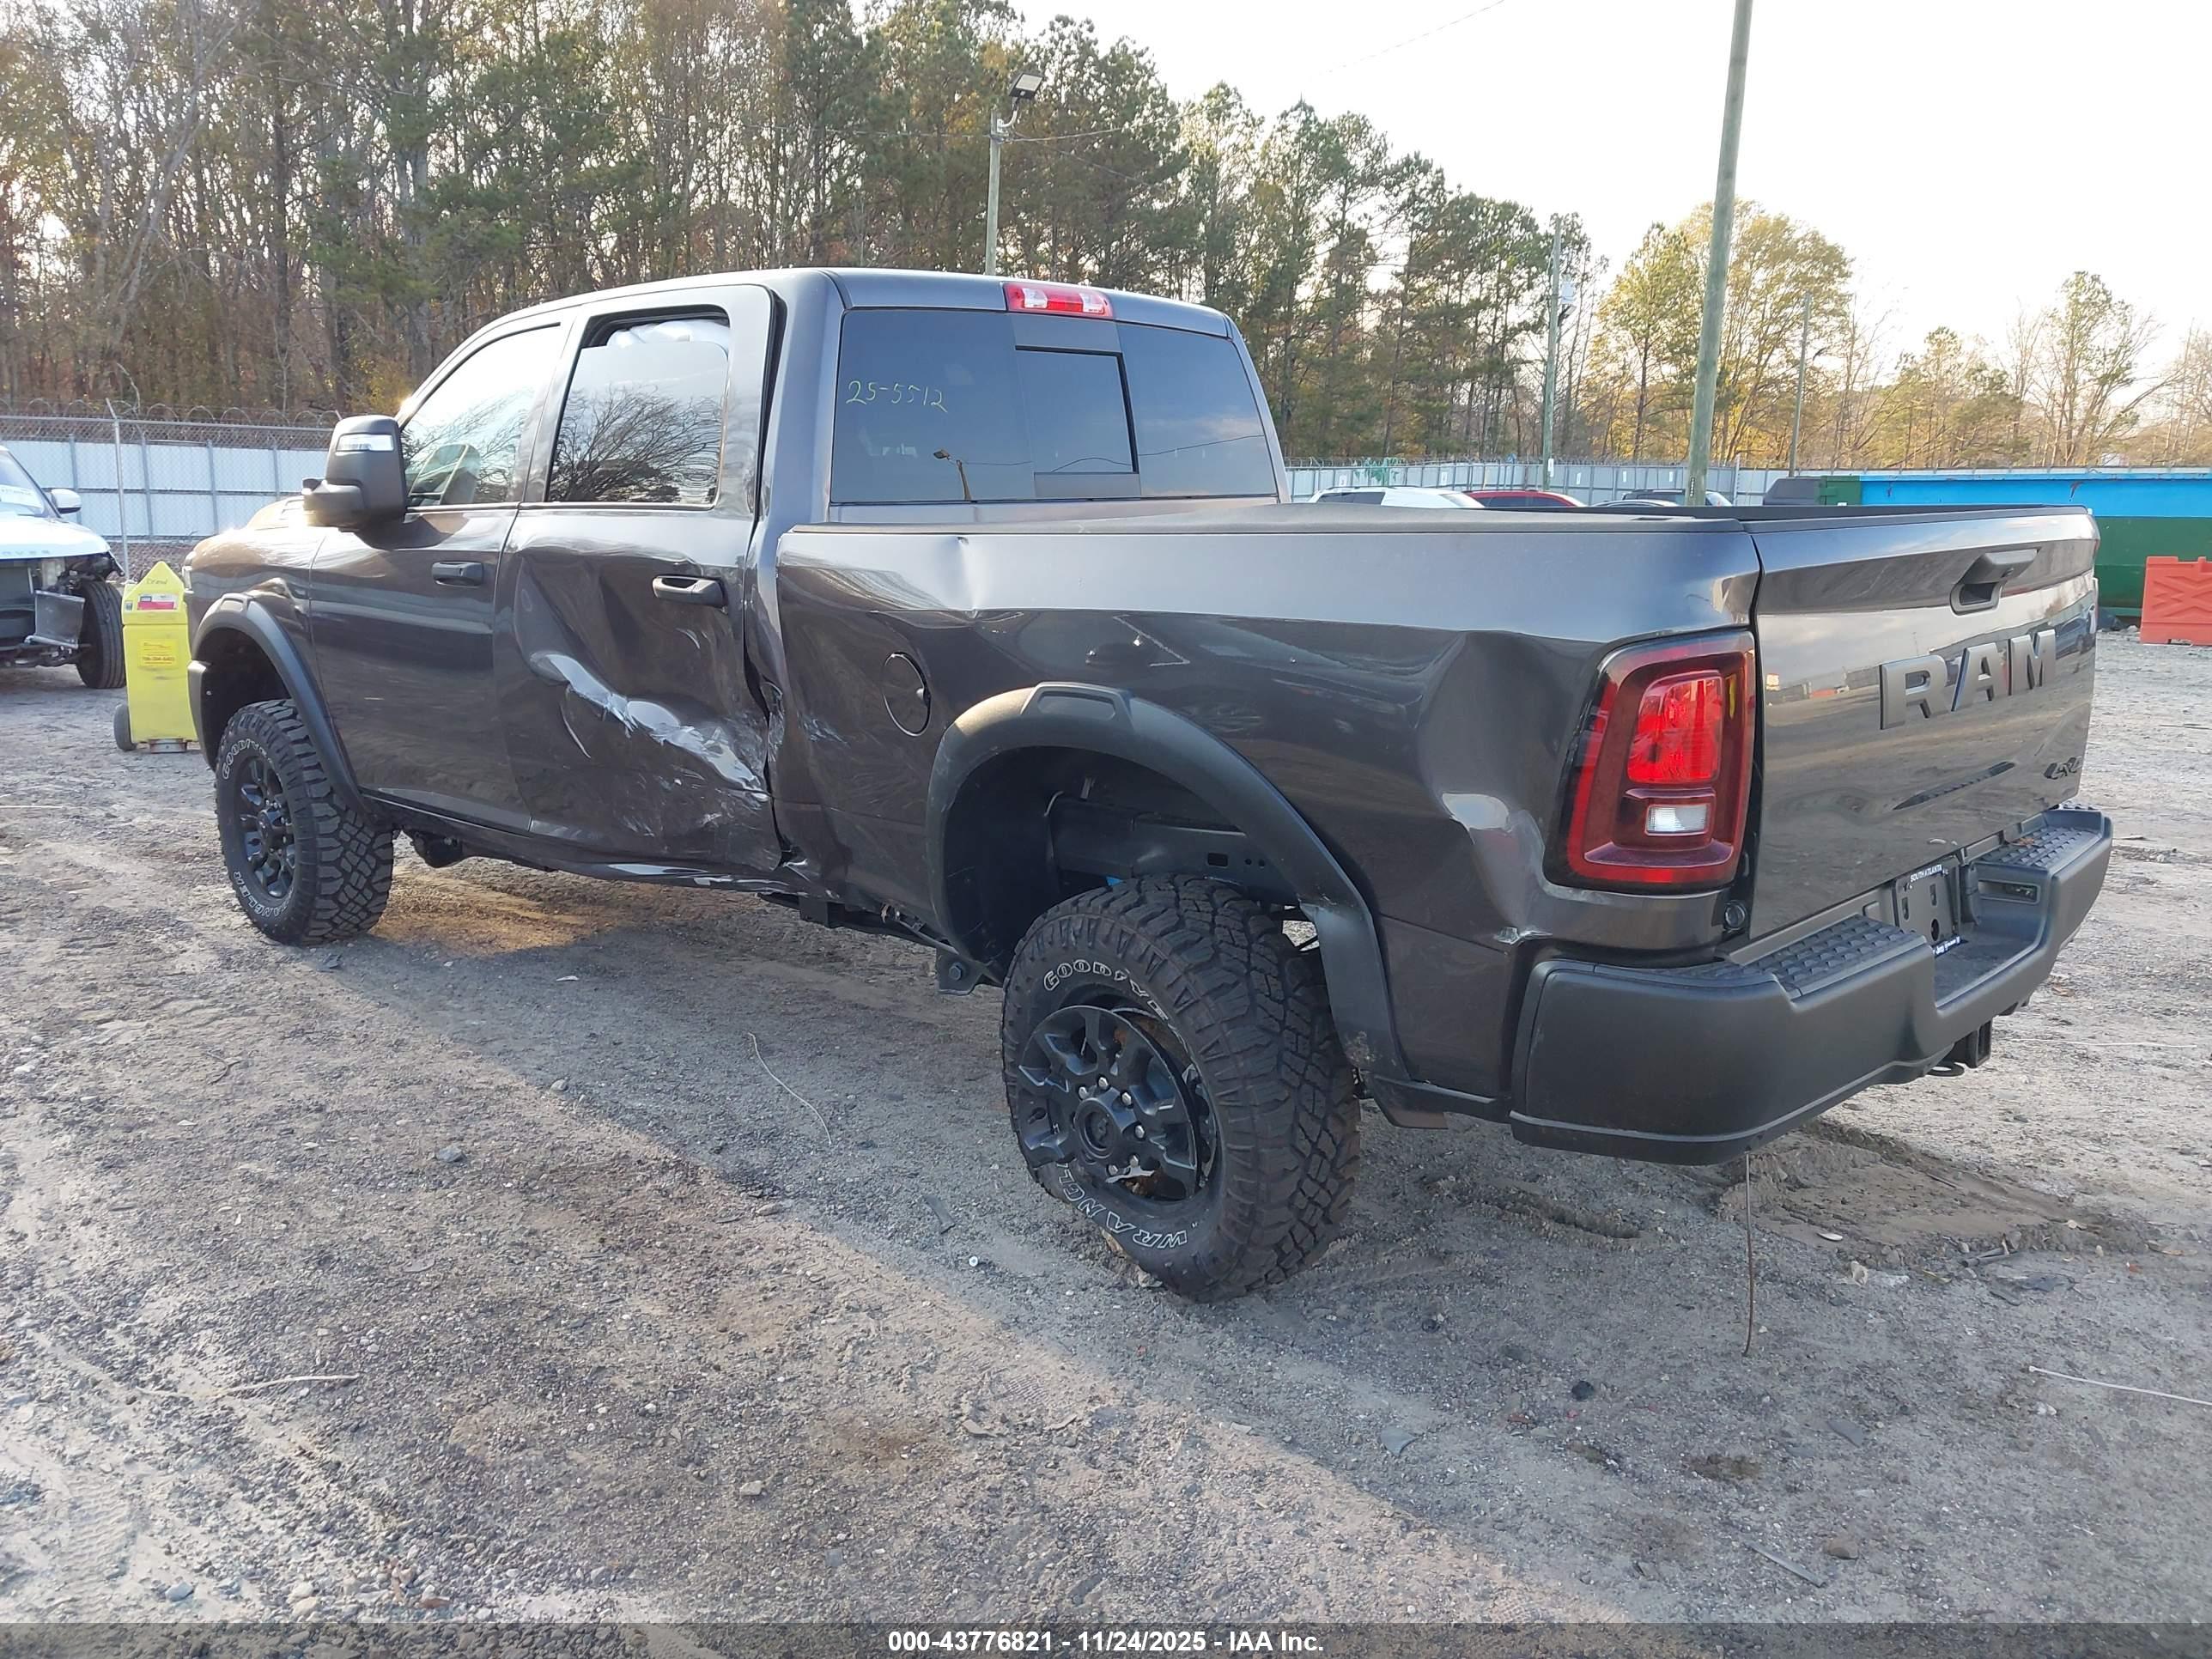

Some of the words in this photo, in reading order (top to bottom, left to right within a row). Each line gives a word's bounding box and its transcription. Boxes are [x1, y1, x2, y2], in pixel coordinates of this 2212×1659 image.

[846, 380, 948, 413] 25-5512
[1879, 629, 2056, 730] RAM
[222, 738, 276, 780] GOODYE
[1043, 958, 1188, 1053] GOODYE
